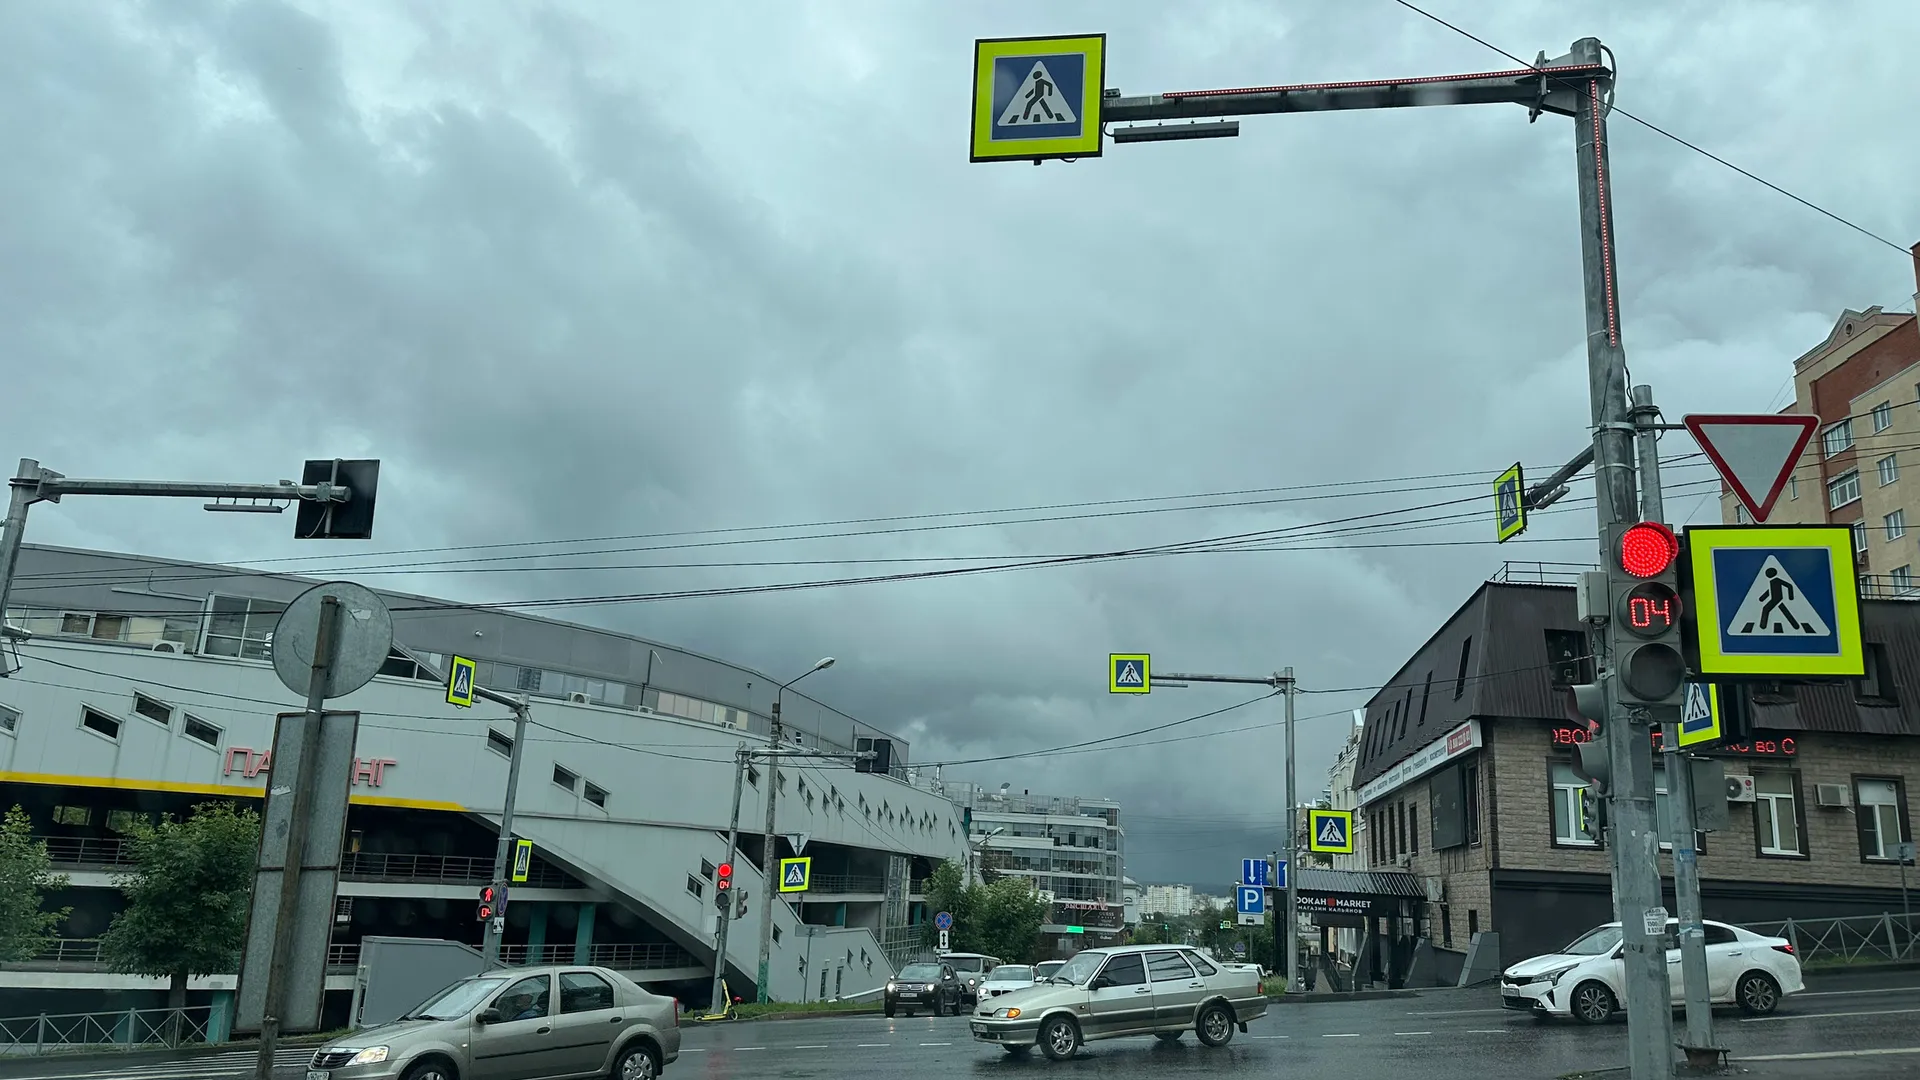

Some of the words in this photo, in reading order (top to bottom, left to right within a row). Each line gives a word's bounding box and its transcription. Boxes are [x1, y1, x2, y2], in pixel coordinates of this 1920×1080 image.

[1630, 598, 1671, 627] 04
[224, 745, 397, 788] ПАНГ
[719, 881, 729, 889] 04
[1244, 889, 1259, 910] P
[1297, 896, 1327, 906] OOKAH
[1336, 899, 1372, 908] MARKET
